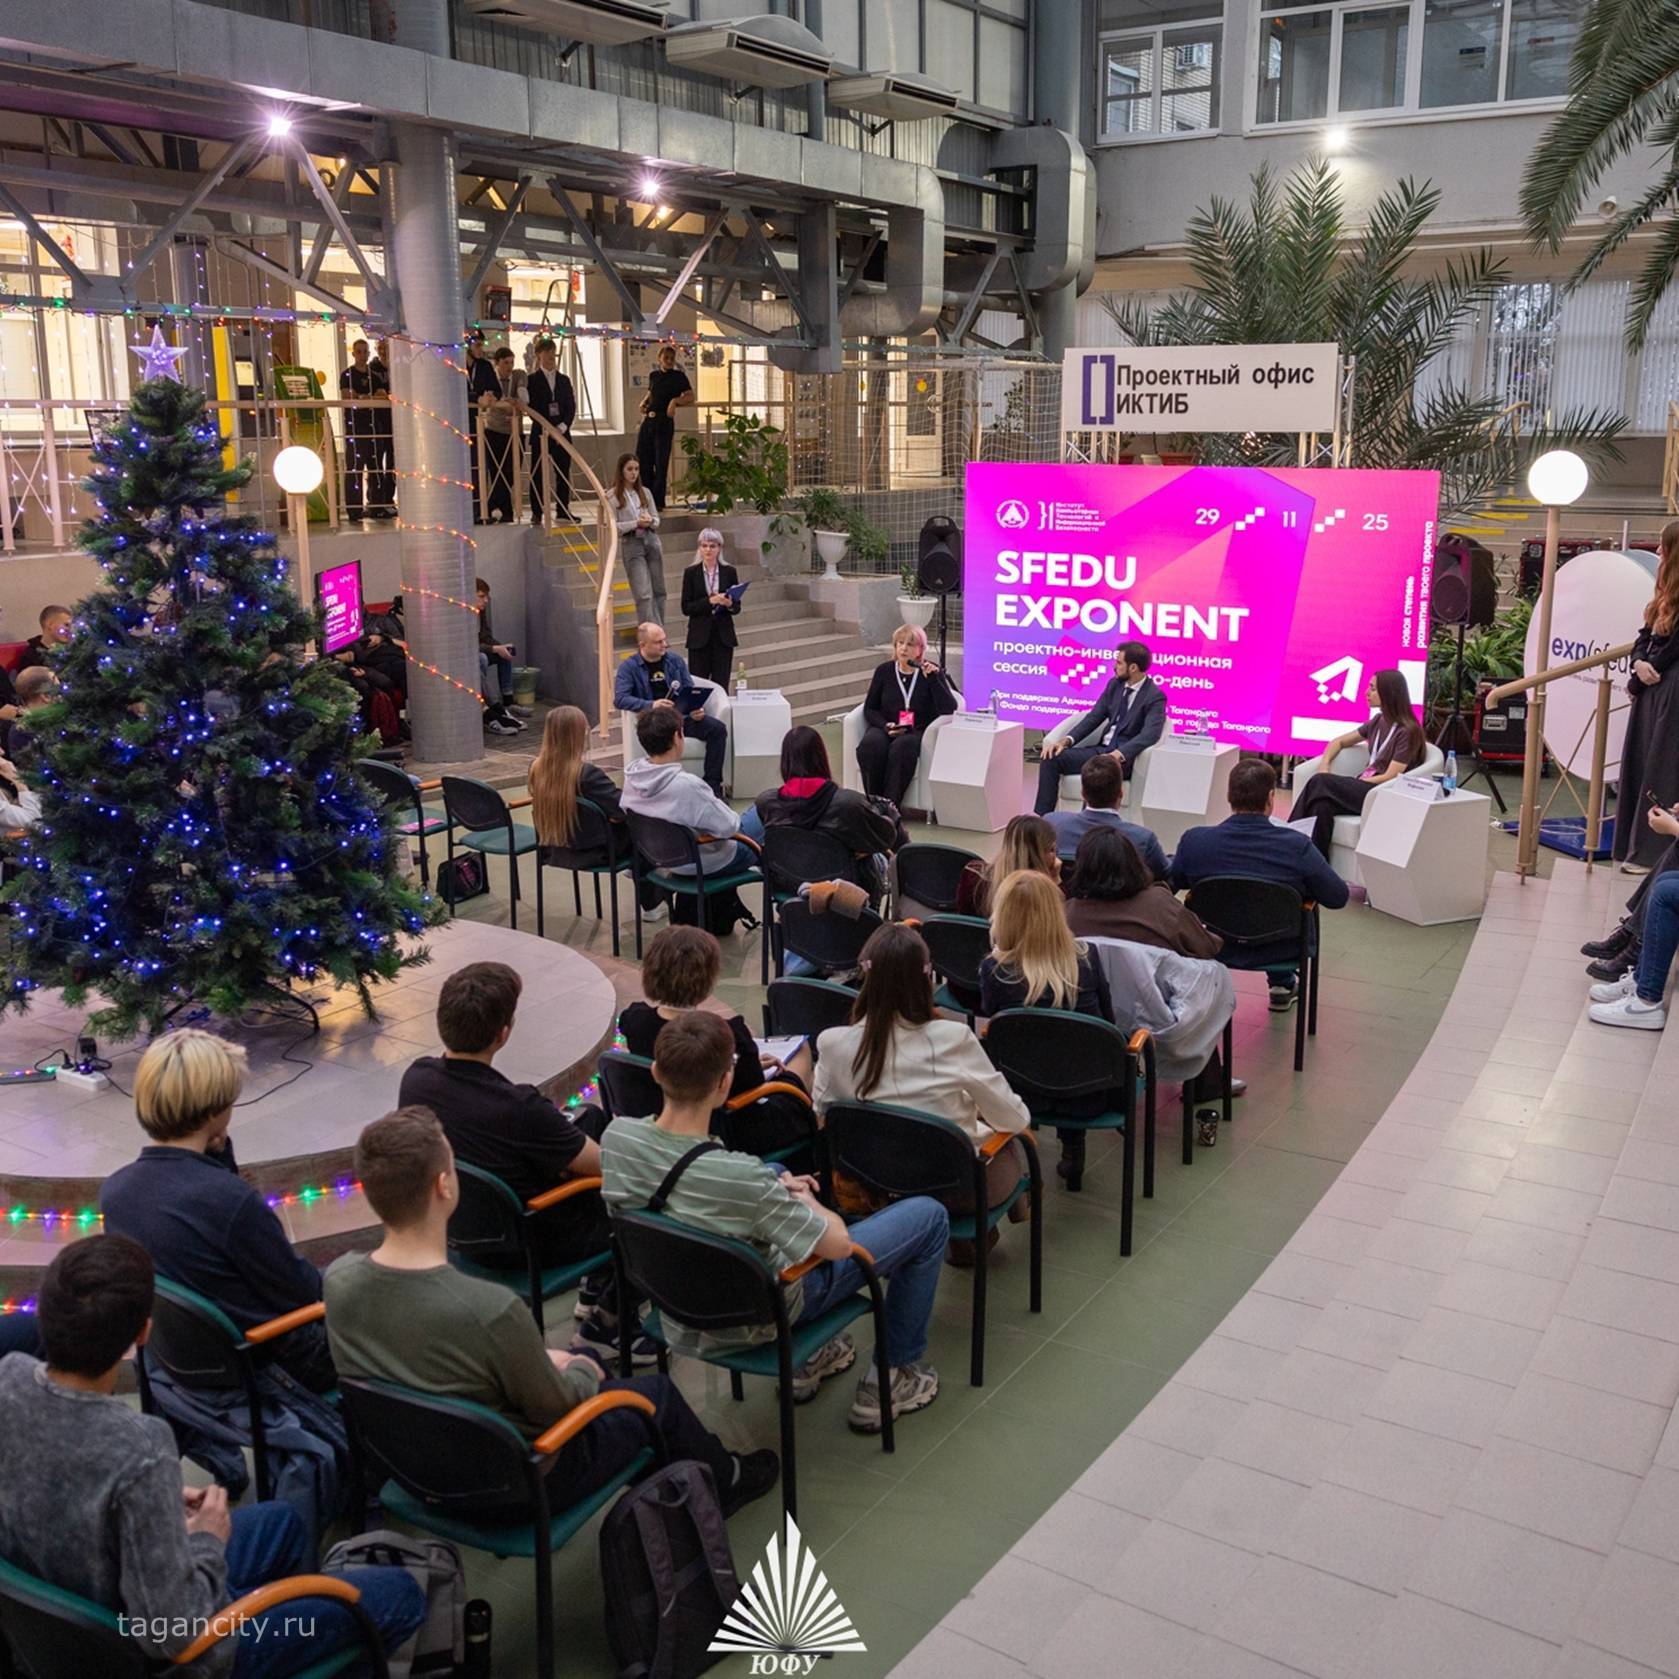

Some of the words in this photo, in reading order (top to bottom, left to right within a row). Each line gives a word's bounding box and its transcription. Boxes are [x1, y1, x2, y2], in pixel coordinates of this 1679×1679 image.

[1117, 364, 1240, 391] Проектный
[1252, 362, 1315, 389] офис
[1116, 393, 1189, 414] ИКТИБ
[1195, 508, 1220, 525] 29
[1282, 511, 1297, 528] 11
[1362, 513, 1389, 531] 25
[1423, 521, 1434, 564] проекта
[995, 550, 1137, 590] SFEDU
[996, 594, 1250, 642] EXPONENT
[993, 660, 1048, 676] сессия
[1221, 721, 1272, 734] Таганрога
